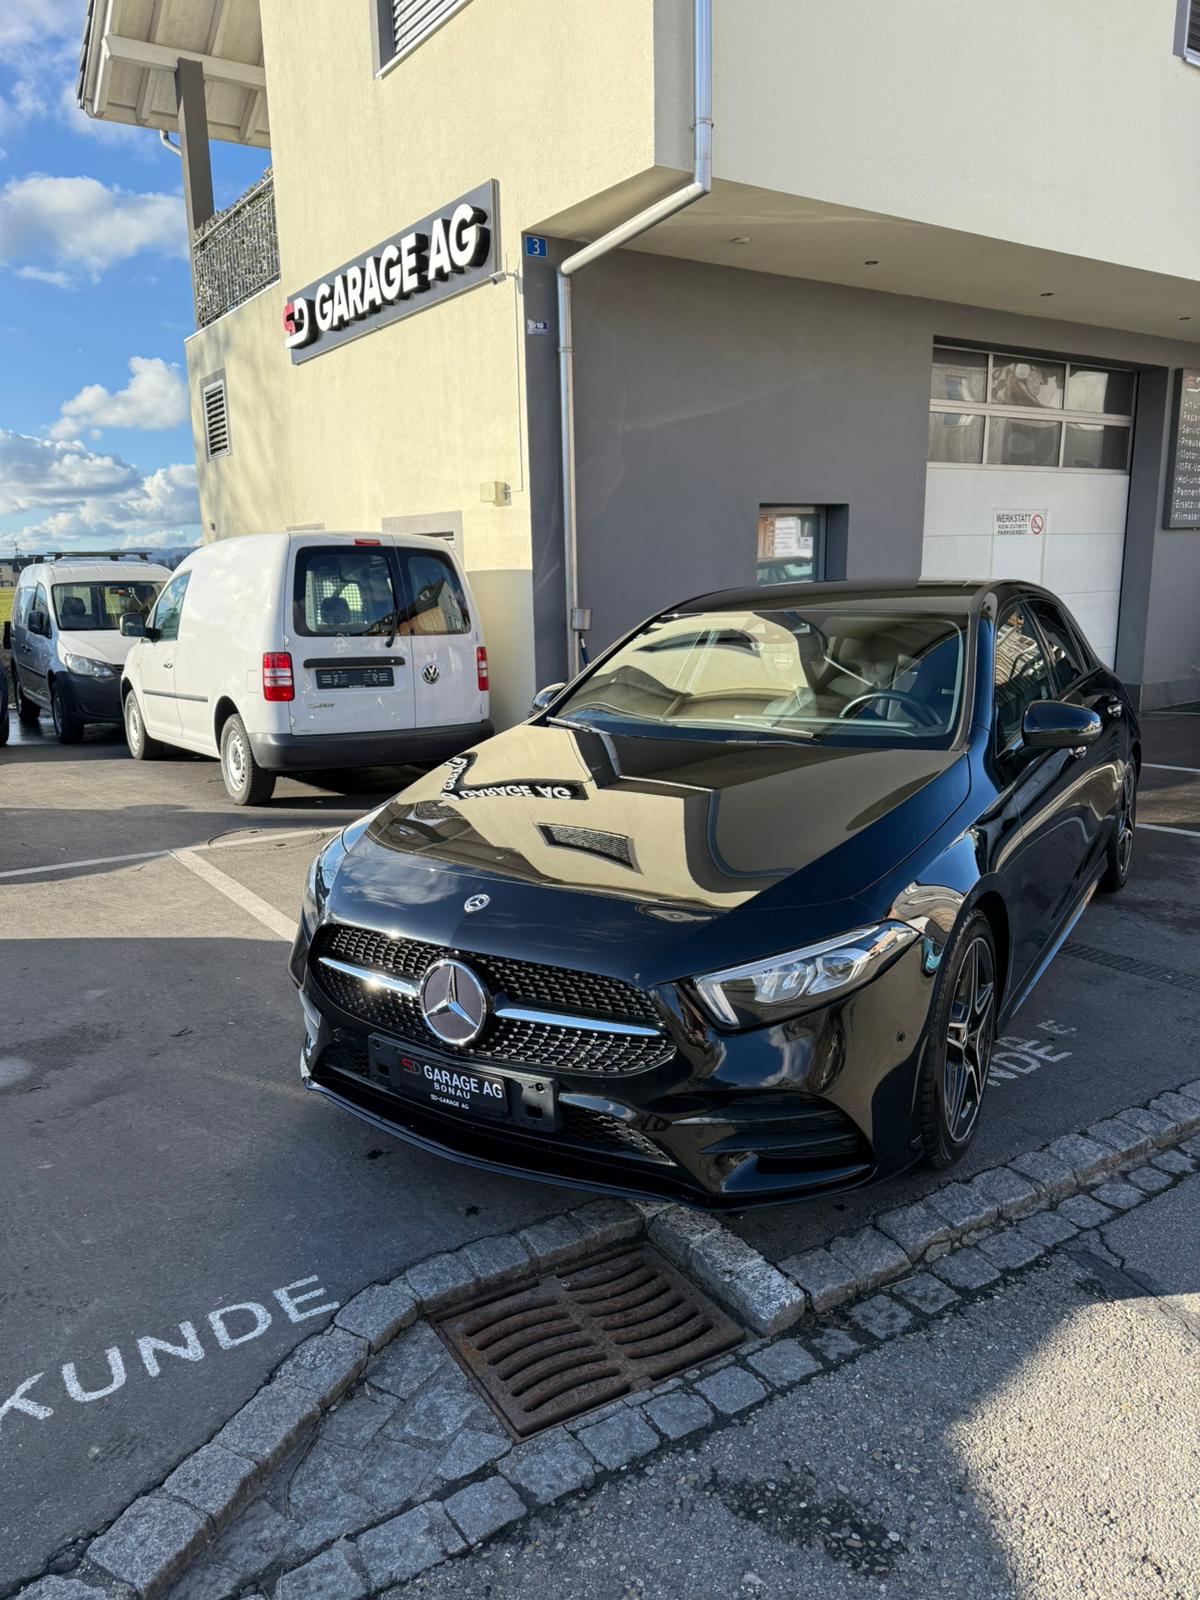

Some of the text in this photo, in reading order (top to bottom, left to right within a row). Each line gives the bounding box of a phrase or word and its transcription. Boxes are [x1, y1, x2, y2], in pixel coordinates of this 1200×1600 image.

[532, 238, 541, 255] 3
[315, 232, 419, 331] GARAGE
[428, 203, 479, 281] AG
[996, 513, 1031, 523] WERKSTATT
[424, 1065, 480, 1093] GARAGE
[483, 1081, 503, 1099] AG
[434, 1082, 470, 1099] BONAU
[430, 1094, 460, 1108] SD-GARAGE
